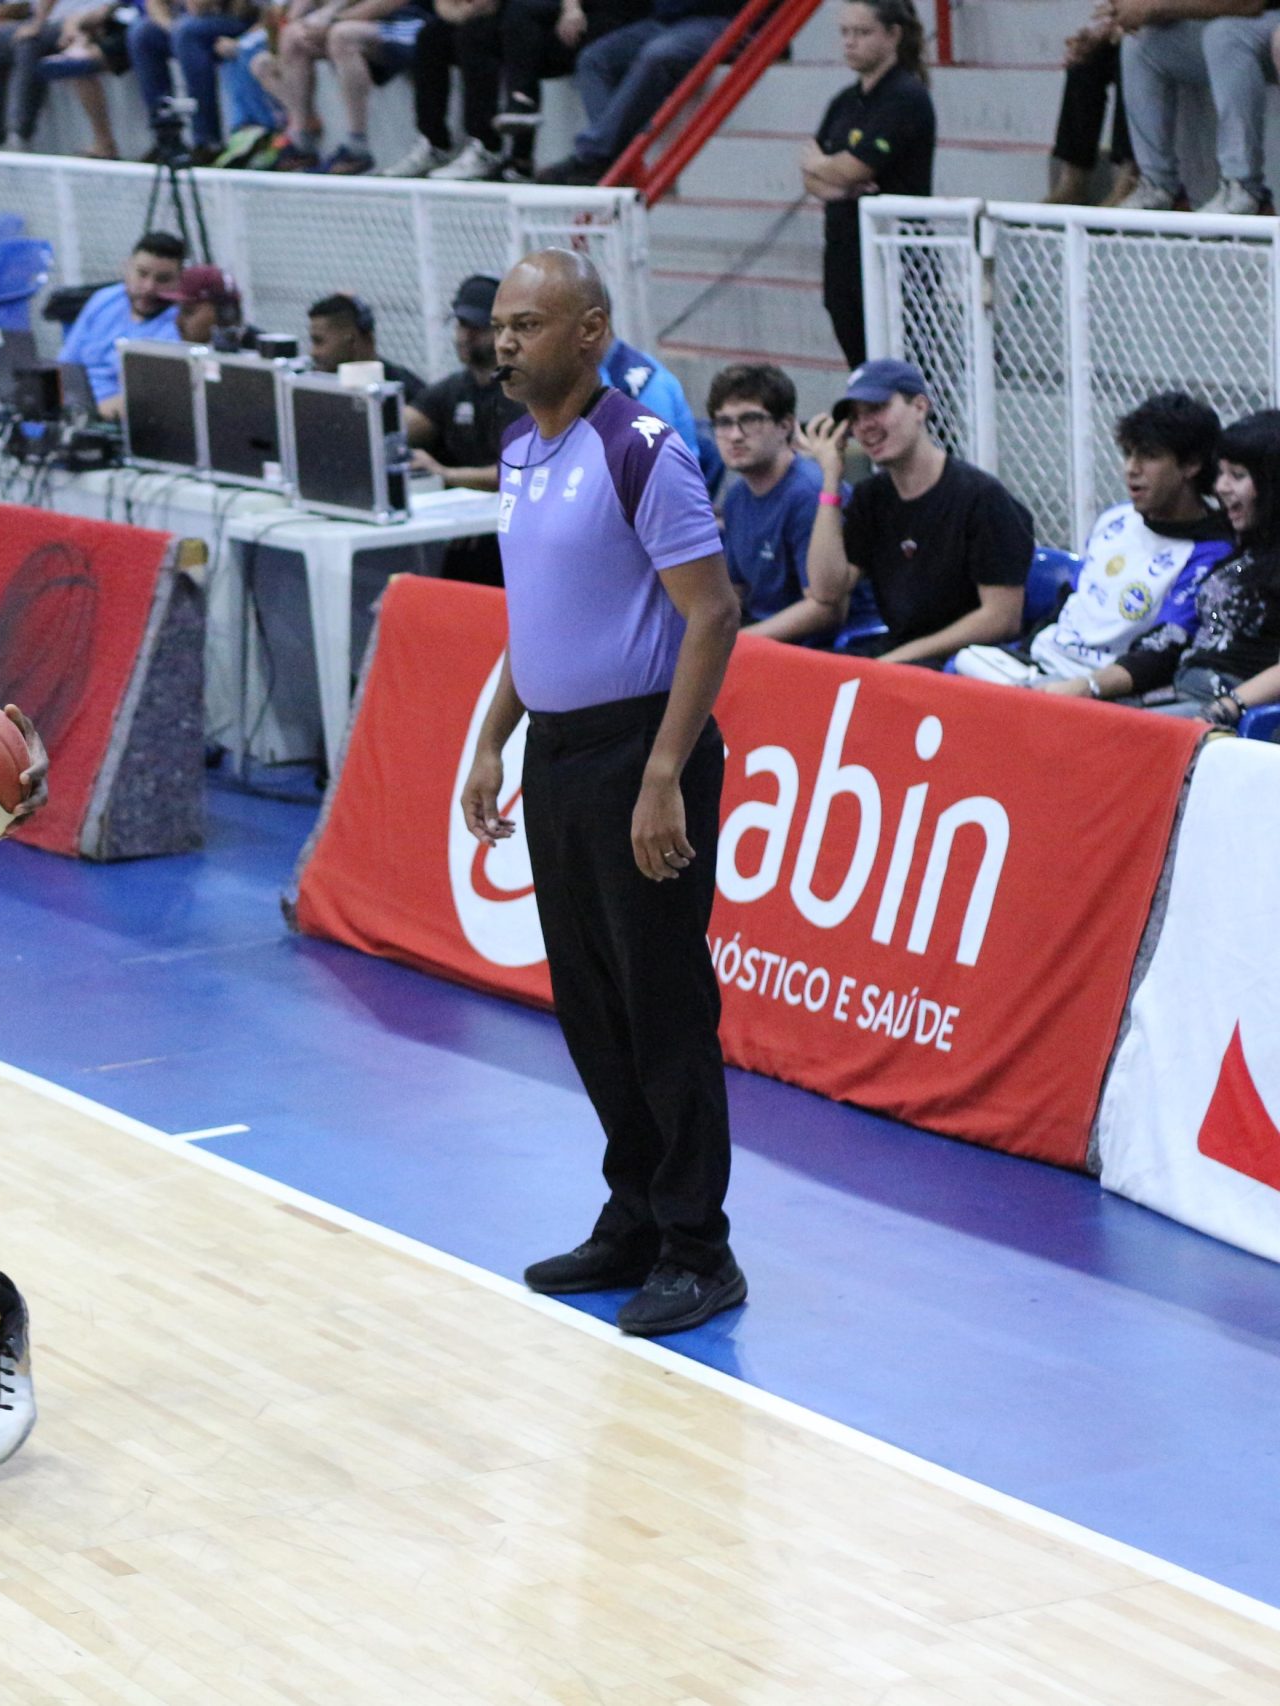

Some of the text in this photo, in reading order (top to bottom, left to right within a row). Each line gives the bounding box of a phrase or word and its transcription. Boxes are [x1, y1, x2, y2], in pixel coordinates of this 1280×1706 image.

[715, 678, 1010, 967] abin
[833, 976, 857, 1022] E
[856, 986, 961, 1052] SAÚDE
